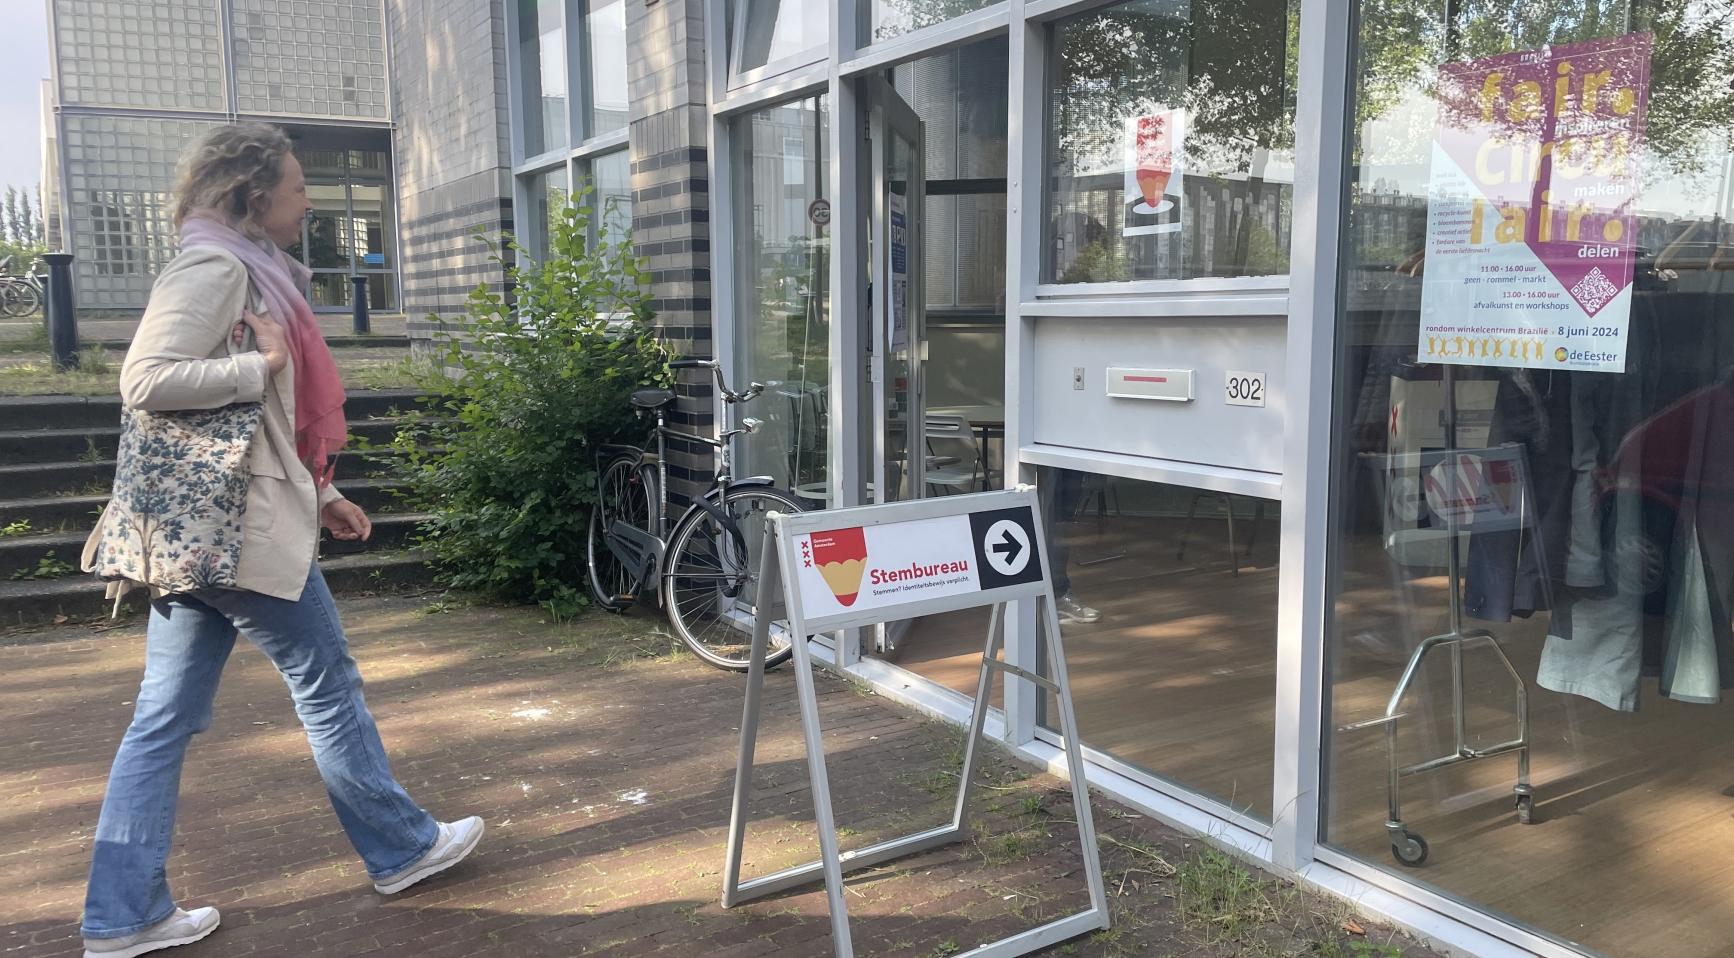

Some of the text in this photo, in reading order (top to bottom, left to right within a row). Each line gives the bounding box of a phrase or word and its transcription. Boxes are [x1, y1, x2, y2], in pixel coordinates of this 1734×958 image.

[1574, 183, 1625, 197] maken
[1578, 244, 1619, 258] delen
[1464, 275, 1546, 285] geen rommel markt
[1473, 301, 1513, 310] afvalkunst
[1526, 302, 1570, 311] workshops
[1425, 325, 1619, 338] rondom winkelcentrum Brazilië 8 juni 2024
[1229, 377, 1261, 400] 302
[870, 560, 968, 585] Stembureau
[873, 586, 902, 596] Stemmen?
[903, 581, 946, 592] Identiteitsbewijs
